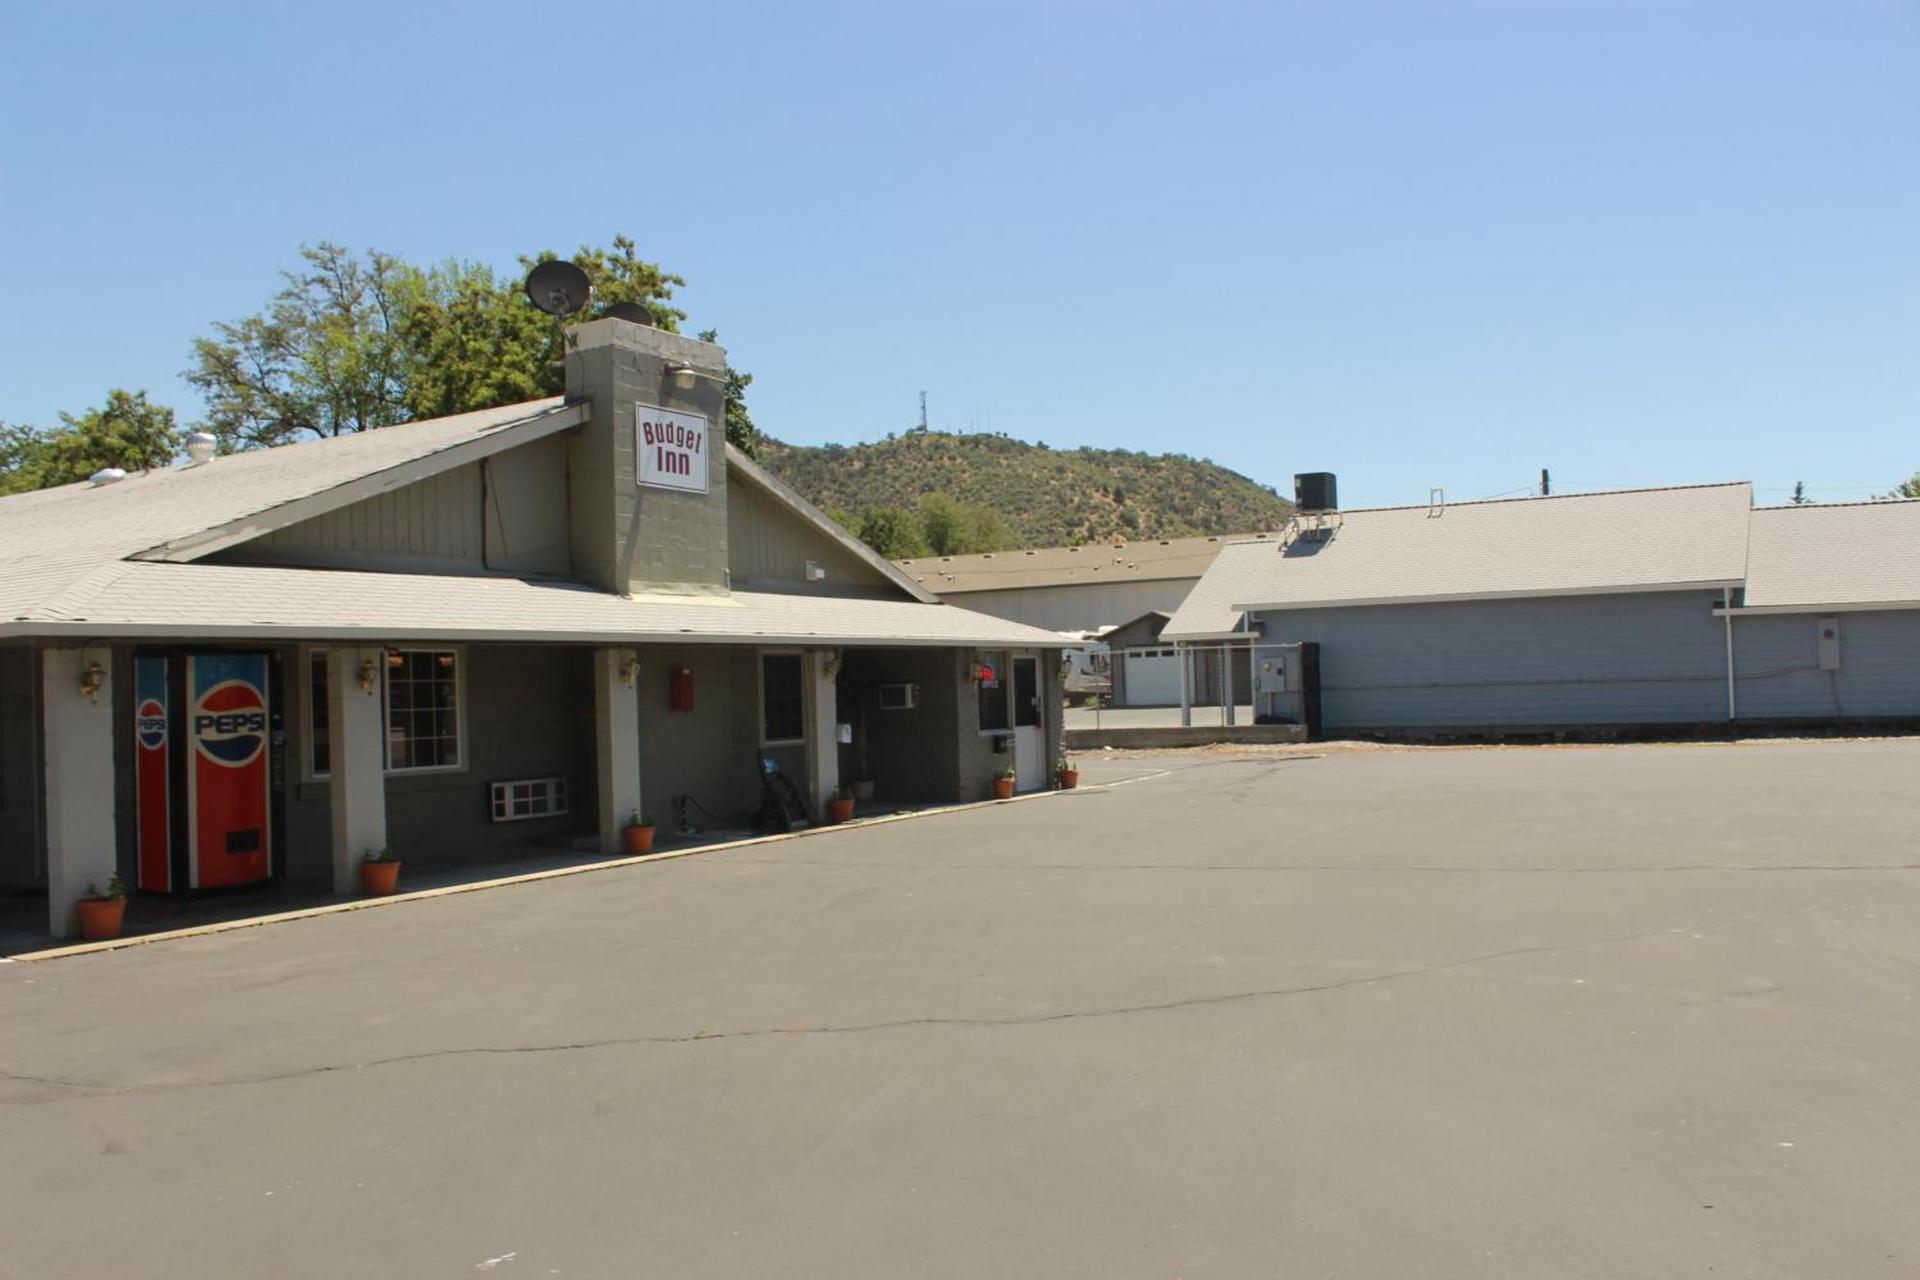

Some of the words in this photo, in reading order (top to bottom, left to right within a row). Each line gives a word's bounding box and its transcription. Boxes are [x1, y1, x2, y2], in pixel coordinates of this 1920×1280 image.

[643, 421, 702, 454] Budget
[657, 446, 690, 476] Inn
[195, 713, 265, 735] PEPSI
